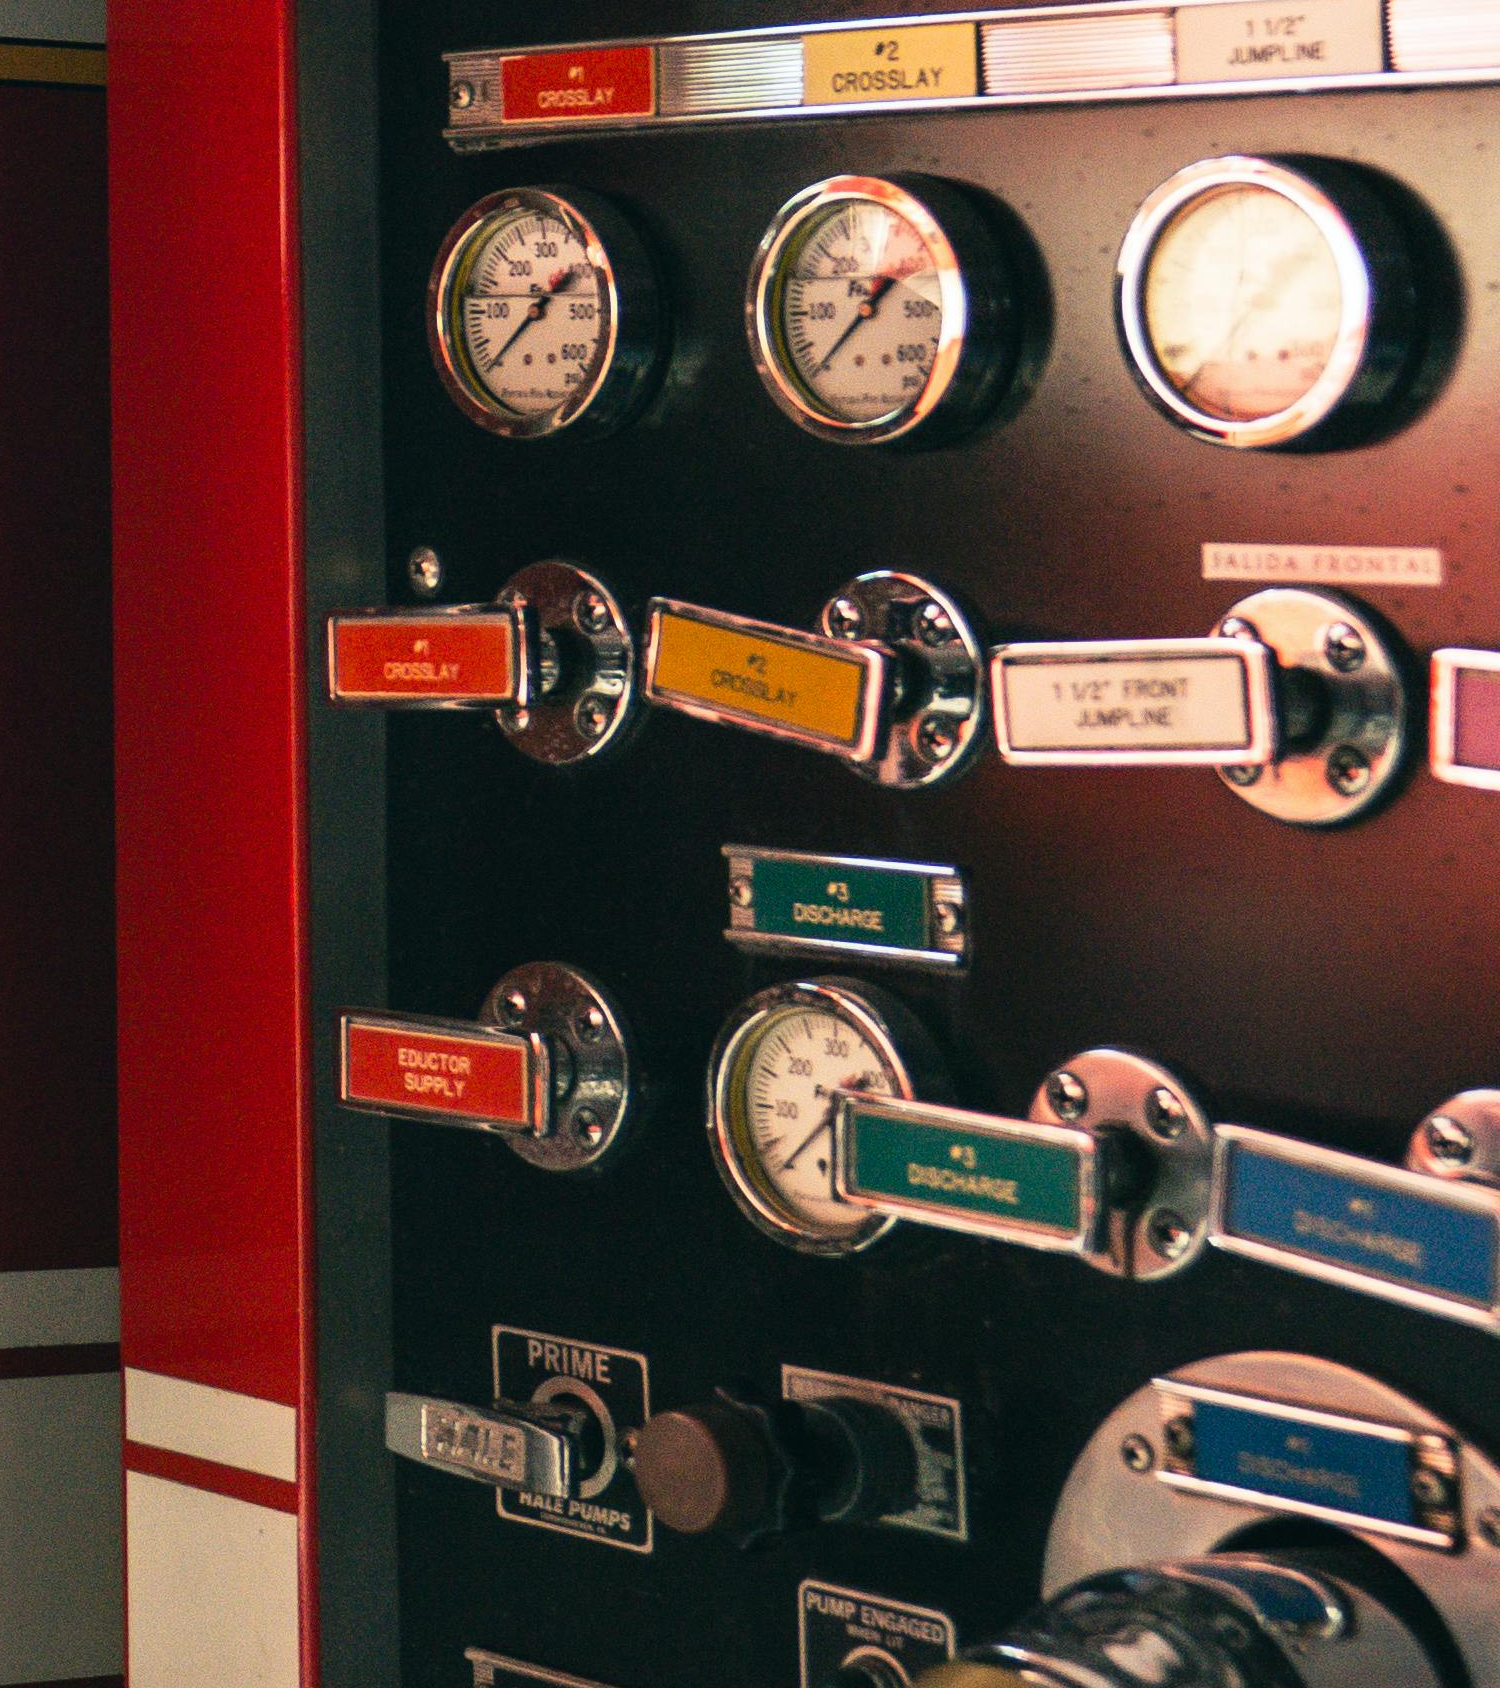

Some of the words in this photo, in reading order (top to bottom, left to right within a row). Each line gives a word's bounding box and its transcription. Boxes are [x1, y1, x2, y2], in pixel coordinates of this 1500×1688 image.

[875, 39, 900, 62] #2
[1227, 40, 1327, 67] JUMPLINE
[831, 66, 944, 94] CROSSLAY
[537, 86, 616, 110] CROSSLAY
[533, 241, 558, 259] 300
[510, 259, 532, 277] 200
[486, 301, 510, 320] 100
[568, 302, 596, 321] 500
[809, 301, 837, 321] 100
[561, 342, 589, 361] 600
[897, 343, 928, 363] 600
[1210, 550, 1300, 573] SALIDA
[1310, 552, 1435, 575] FRONTAL
[382, 661, 461, 682] CROSSLAY
[710, 668, 799, 708] CROSSLAY
[1121, 676, 1189, 701] FRONT
[1075, 706, 1176, 730] JUMPLINE
[793, 902, 885, 933] DISCHARGE
[824, 1037, 850, 1058] 300
[398, 1047, 472, 1075] EDUCTOR
[403, 1071, 466, 1098] SUPPLY
[906, 1162, 1019, 1205] DISCHARGE
[526, 1337, 613, 1385] PRIME
[518, 1491, 565, 1515] HALE
[568, 1499, 632, 1532] PUMPS
[806, 1590, 856, 1620] PUMP
[860, 1604, 946, 1646] ENGAGED
